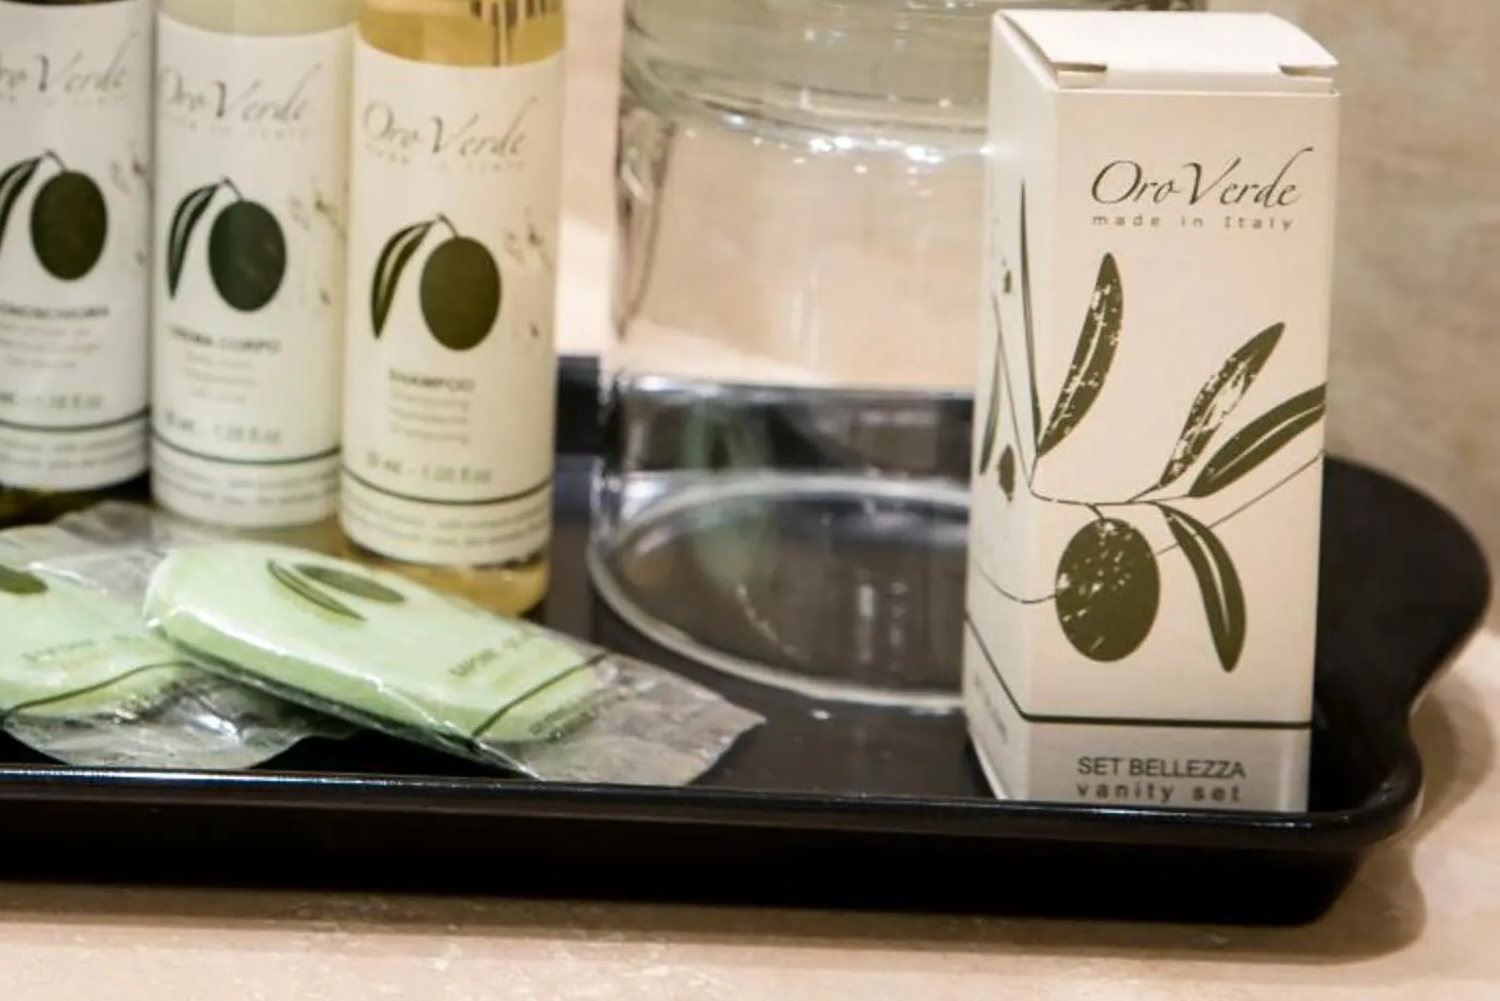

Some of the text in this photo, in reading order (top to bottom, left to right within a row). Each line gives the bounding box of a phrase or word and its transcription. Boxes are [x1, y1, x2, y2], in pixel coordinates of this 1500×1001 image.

[1092, 214, 1294, 232] made in Italy
[1077, 757, 1246, 780] SET BELLEZZA
[1077, 782, 1242, 804] vanity set
